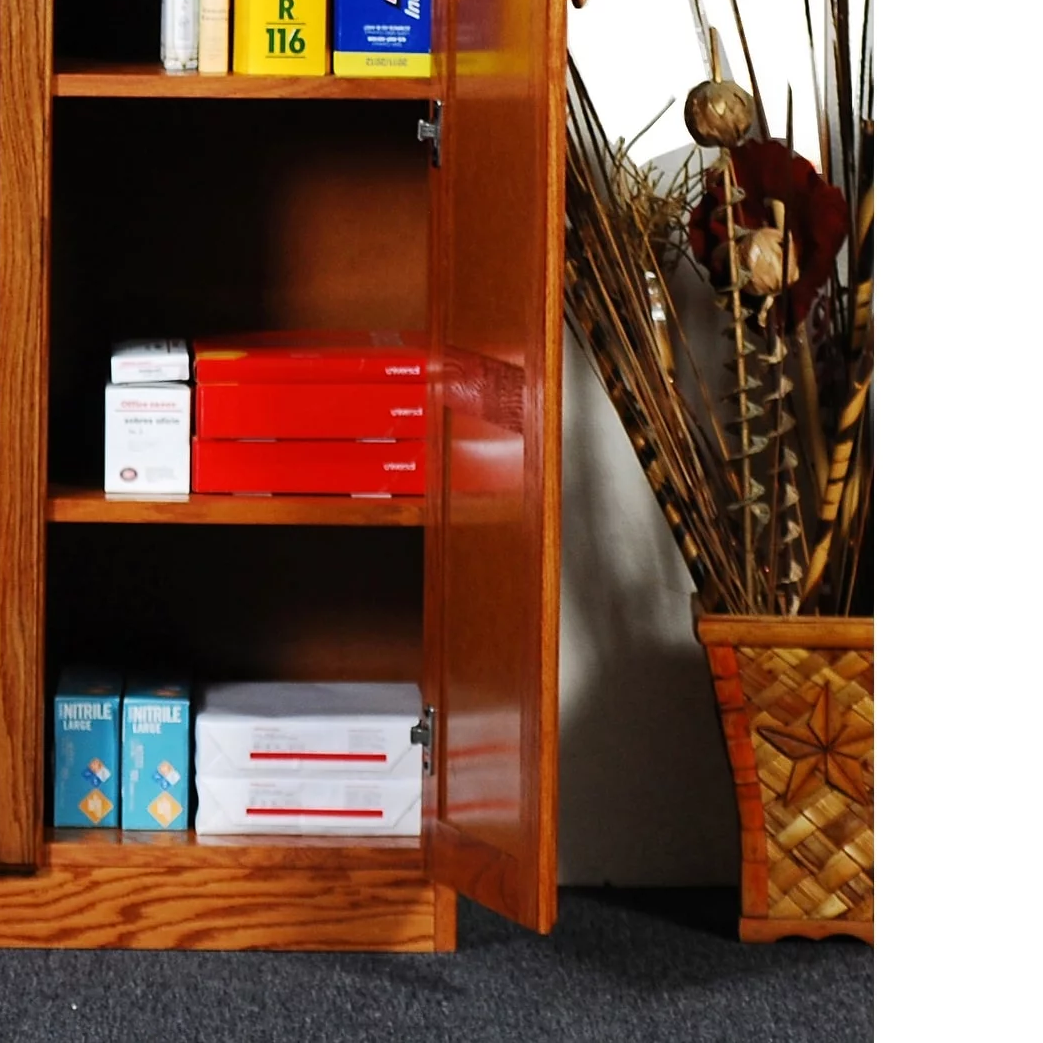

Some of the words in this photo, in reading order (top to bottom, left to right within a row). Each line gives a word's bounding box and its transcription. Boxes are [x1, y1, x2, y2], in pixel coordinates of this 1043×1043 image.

[265, 28, 306, 54] 116
[63, 702, 113, 720] NITRILE
[133, 705, 182, 723] NITRILE
[62, 720, 92, 731] LARGE
[132, 723, 161, 734] LARGE
